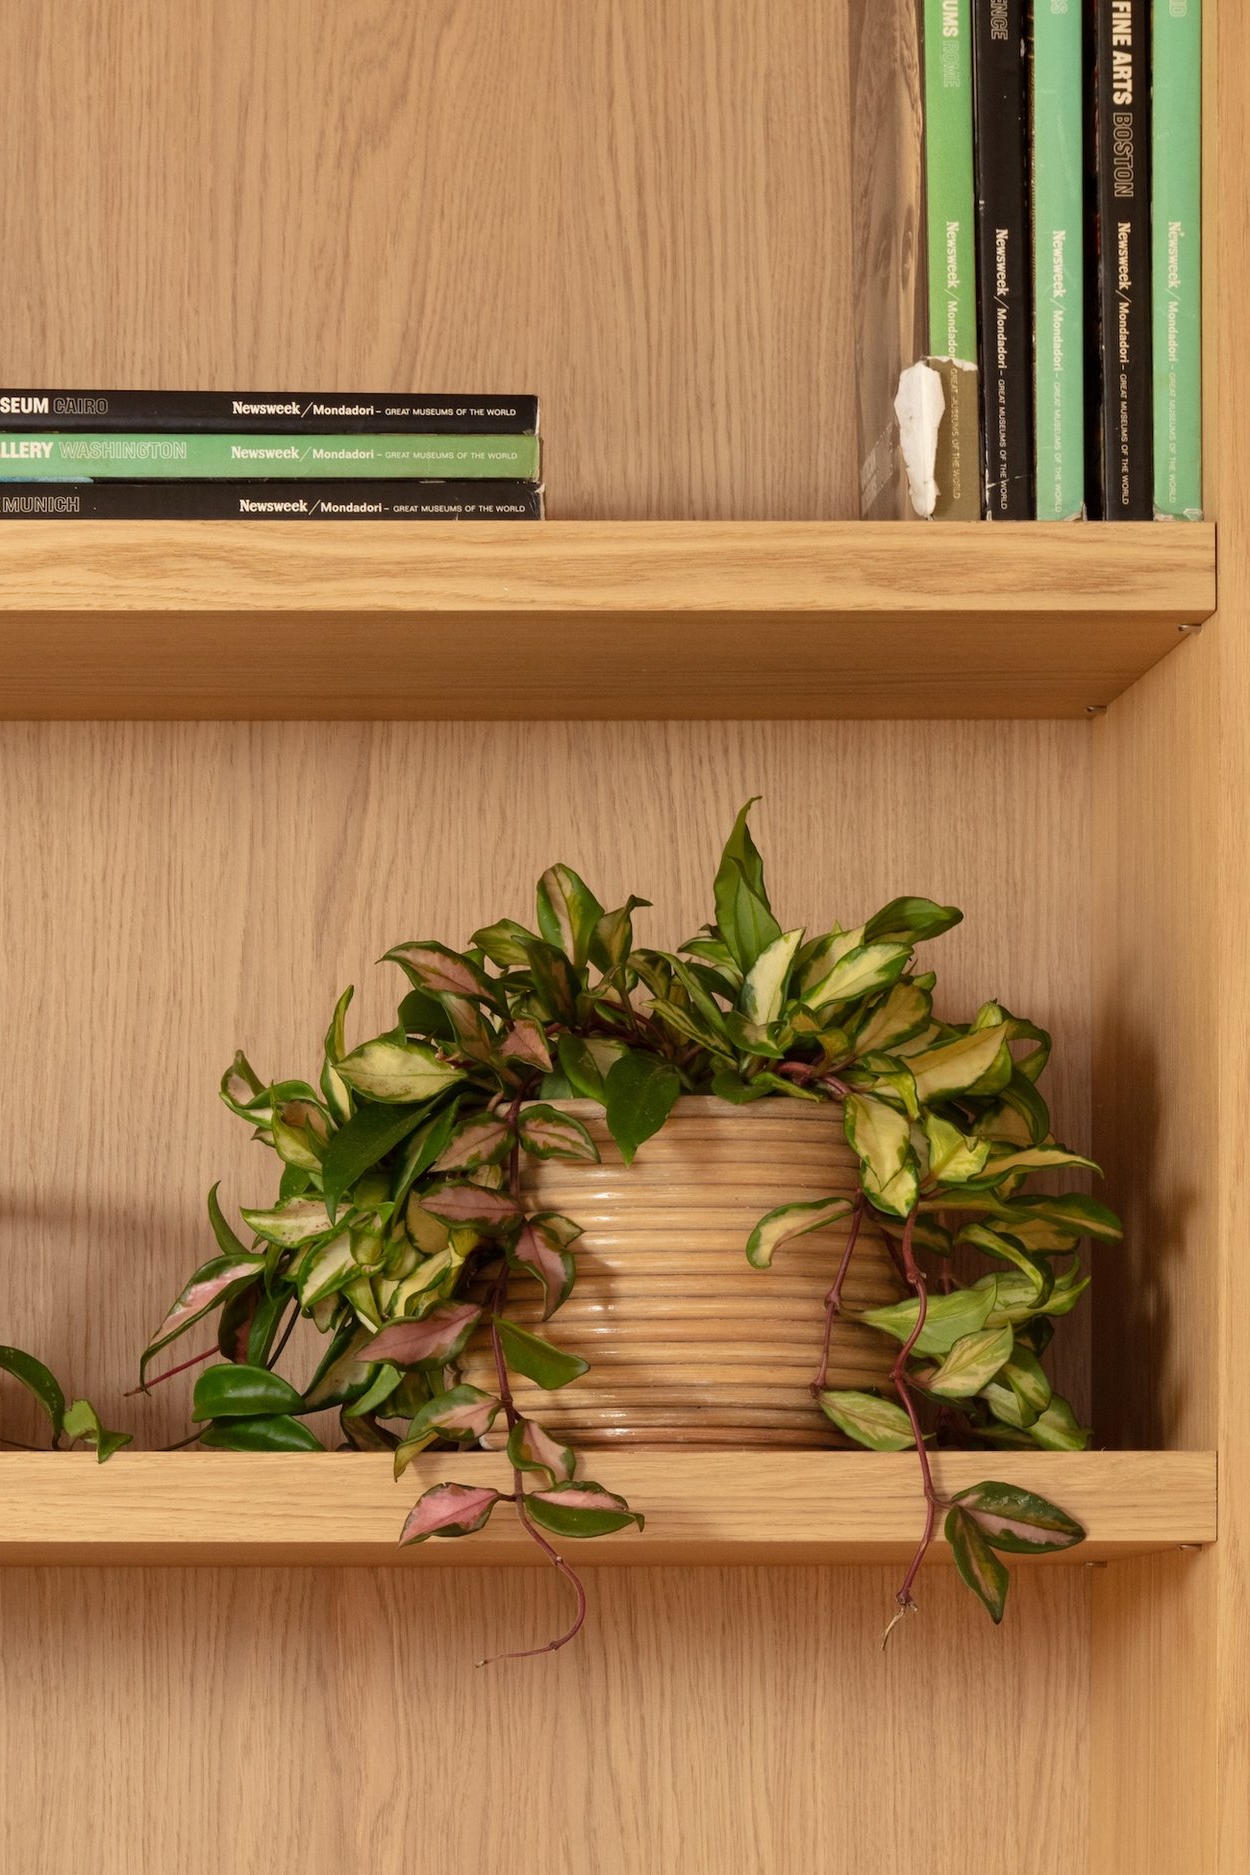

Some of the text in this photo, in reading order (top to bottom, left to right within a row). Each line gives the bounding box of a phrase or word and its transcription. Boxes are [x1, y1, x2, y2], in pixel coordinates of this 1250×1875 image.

[943, 40, 960, 88] ROME
[1111, 0, 1134, 198] FINE ARTS BOSTON
[998, 379, 1007, 404] GREAT
[1054, 382, 1062, 406] GREAT
[1119, 373, 1128, 398] GREAT
[53, 398, 108, 414] CAIRO
[385, 408, 410, 416] GREAT
[412, 408, 453, 416] MUSEUMS
[456, 408, 467, 416] OF
[470, 408, 484, 416] THE
[487, 408, 516, 416] WORLD
[999, 407, 1007, 448] MUSEUMS
[1054, 409, 1062, 450] MUSEUMS
[1120, 401, 1129, 442] MUSEUMS
[59, 442, 187, 460] WASHINGTON
[471, 452, 485, 460] THE
[488, 452, 517, 460] WORLD
[999, 449, 1007, 461] OF
[1054, 452, 1062, 464] OF
[1121, 444, 1129, 455] OF
[1169, 443, 1176, 455] OF
[1054, 465, 1062, 480] THE
[1121, 457, 1129, 472] THE
[1000, 480, 1008, 510] WORLD
[1054, 482, 1062, 513] WORLD
[1121, 474, 1129, 505] WORLD
[2, 497, 80, 513] MUNICH
[393, 505, 418, 513] GREAT
[421, 505, 462, 513] MUSEUMS
[464, 505, 476, 513] OF
[479, 505, 493, 513] THE
[496, 505, 526, 513] WORLD
